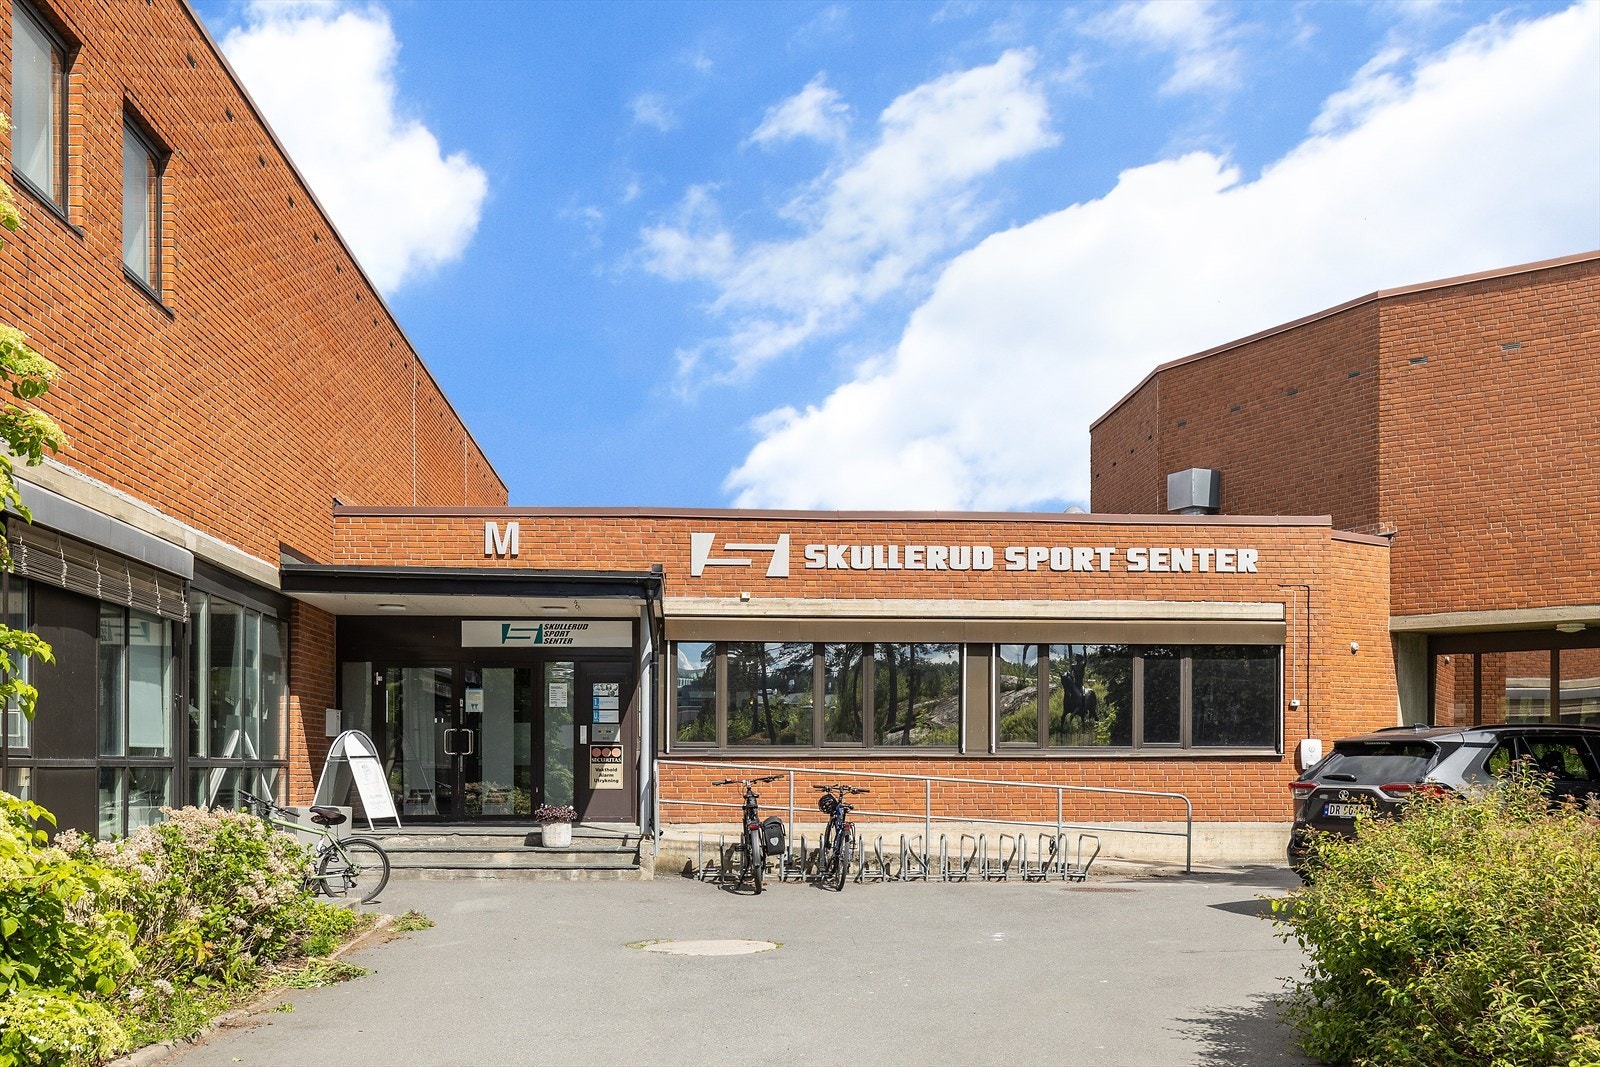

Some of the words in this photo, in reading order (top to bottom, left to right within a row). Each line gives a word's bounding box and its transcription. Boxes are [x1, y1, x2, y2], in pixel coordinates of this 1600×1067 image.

[484, 521, 520, 556] M
[804, 544, 994, 571] SKULLERUD
[1005, 546, 1116, 572] SPORT
[1126, 547, 1259, 573] SENTER
[543, 637, 574, 645] SENTER
[1329, 804, 1341, 815] DR
